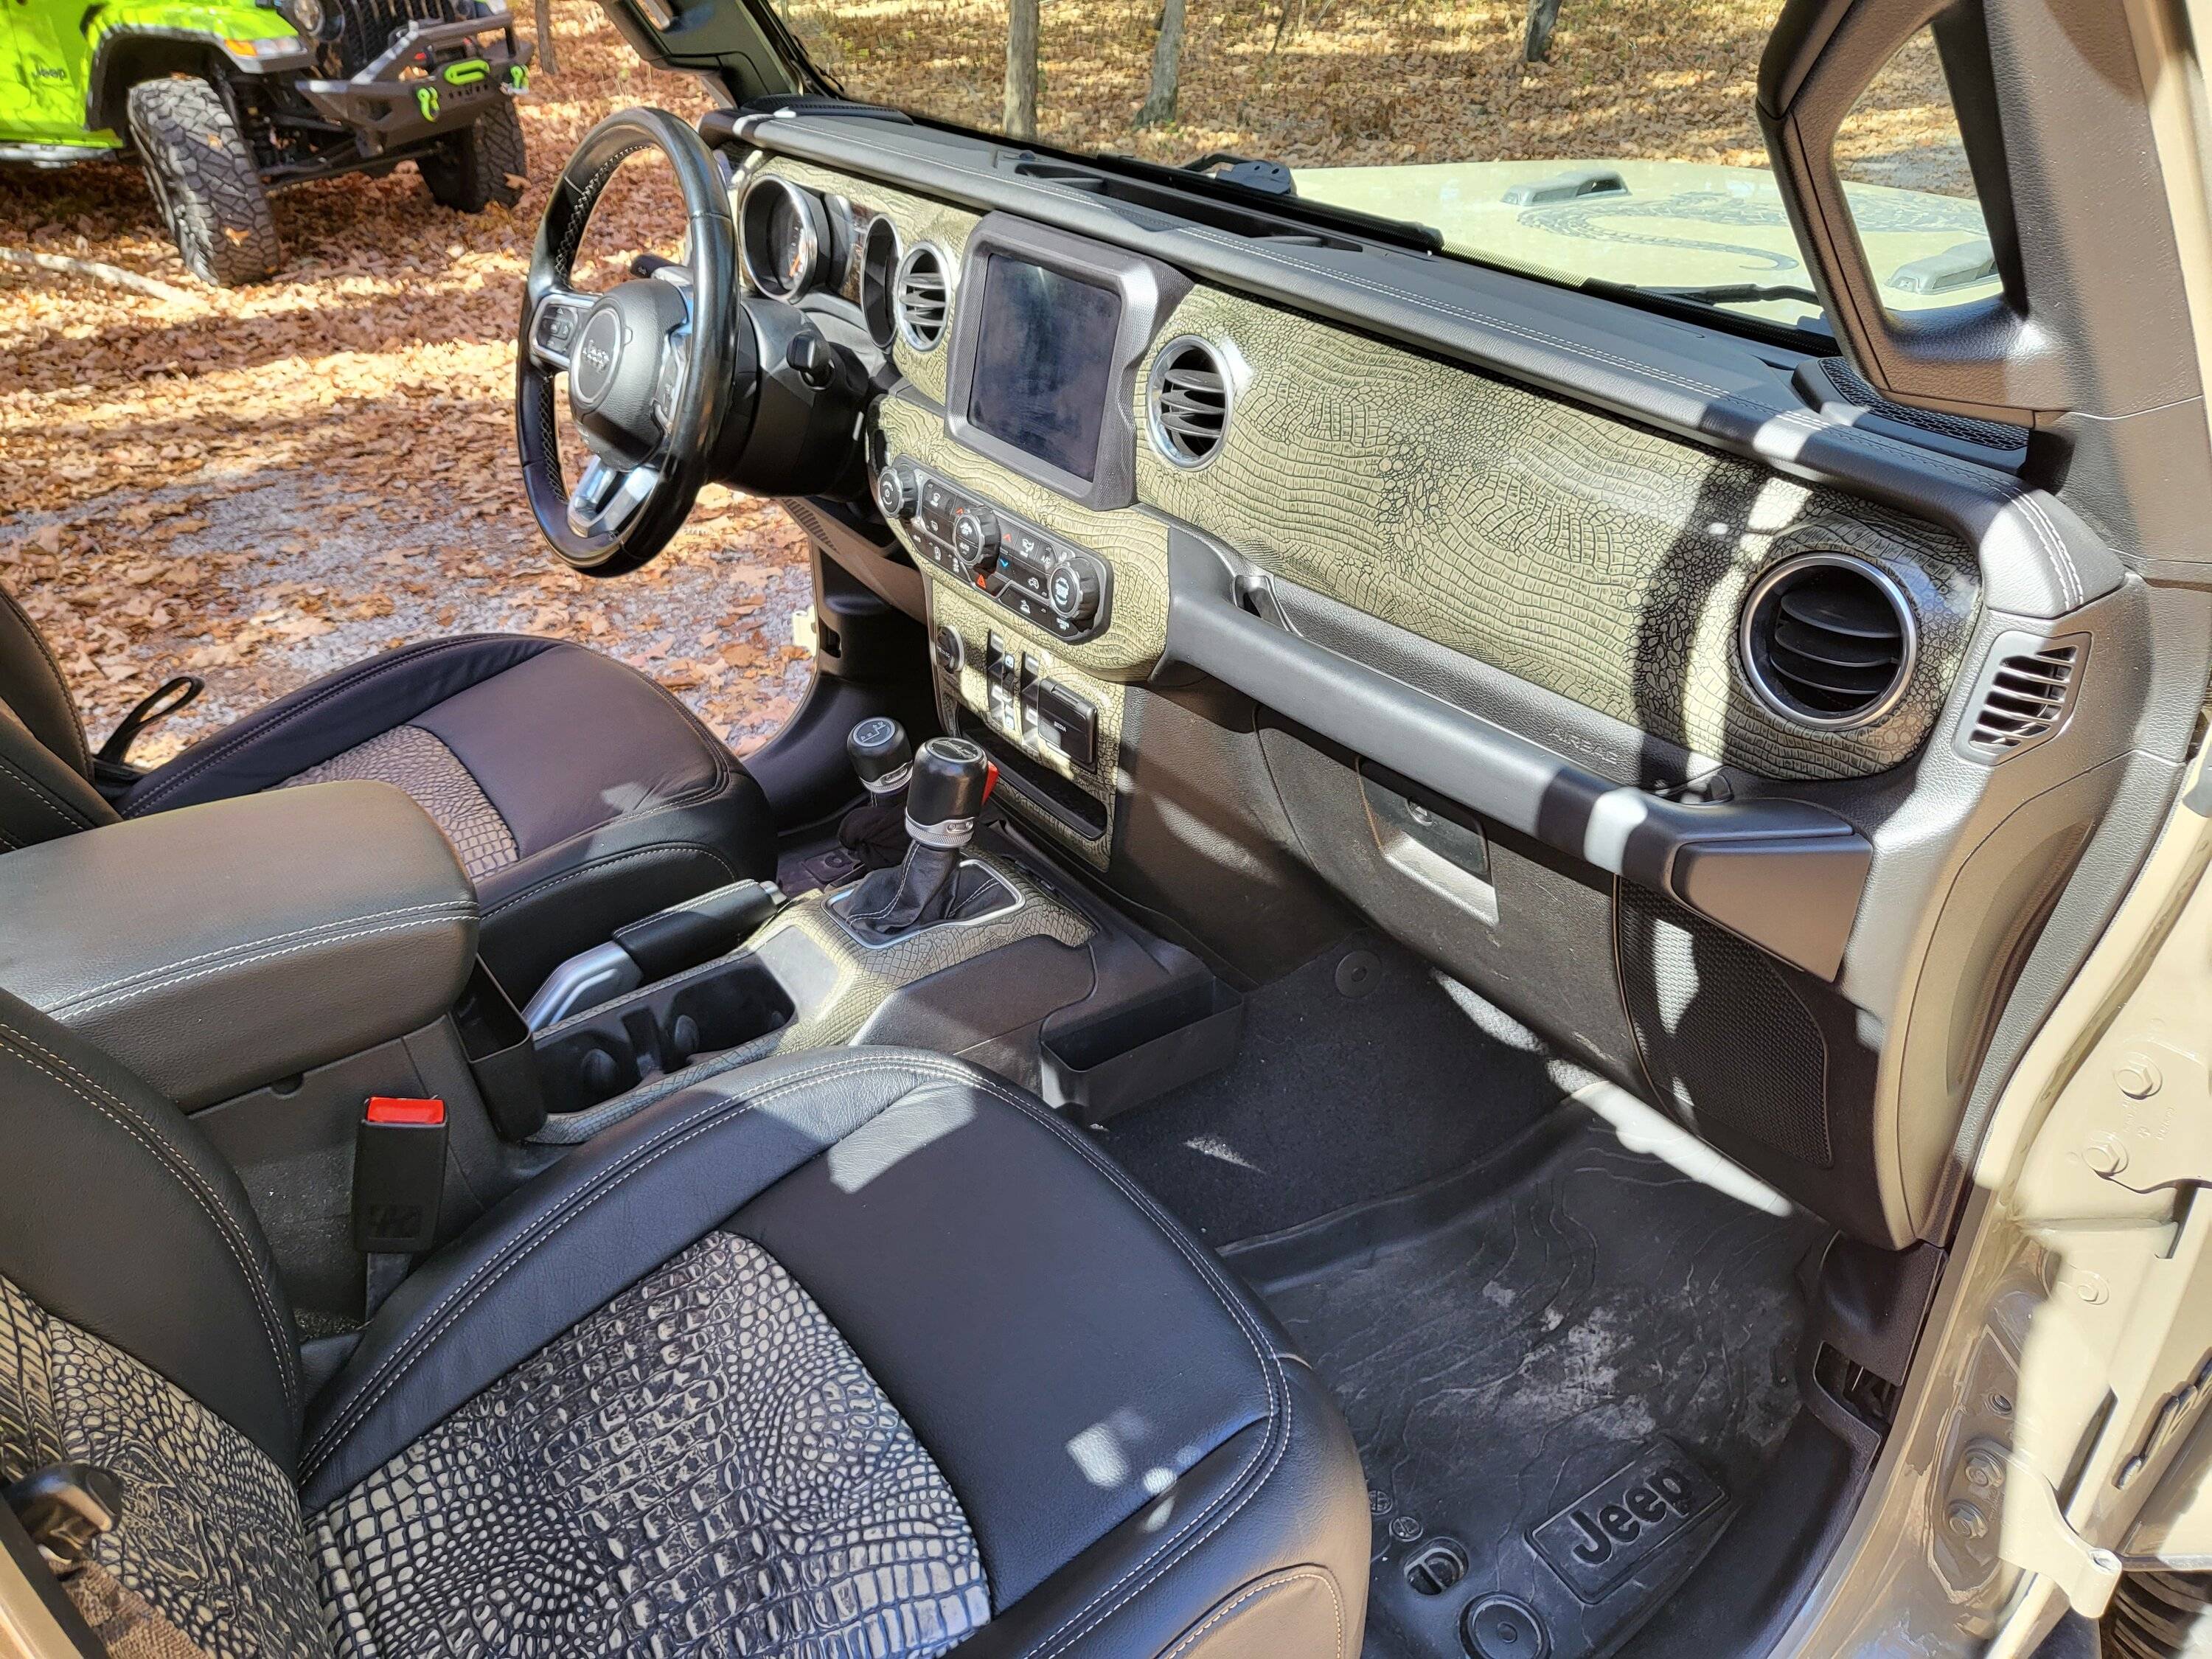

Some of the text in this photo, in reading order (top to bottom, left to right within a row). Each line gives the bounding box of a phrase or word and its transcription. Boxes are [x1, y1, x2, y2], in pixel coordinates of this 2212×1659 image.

[31, 63, 67, 81] Jeep
[1548, 726, 1618, 765] AIRBAG
[1569, 1470, 1693, 1565] Jeep
